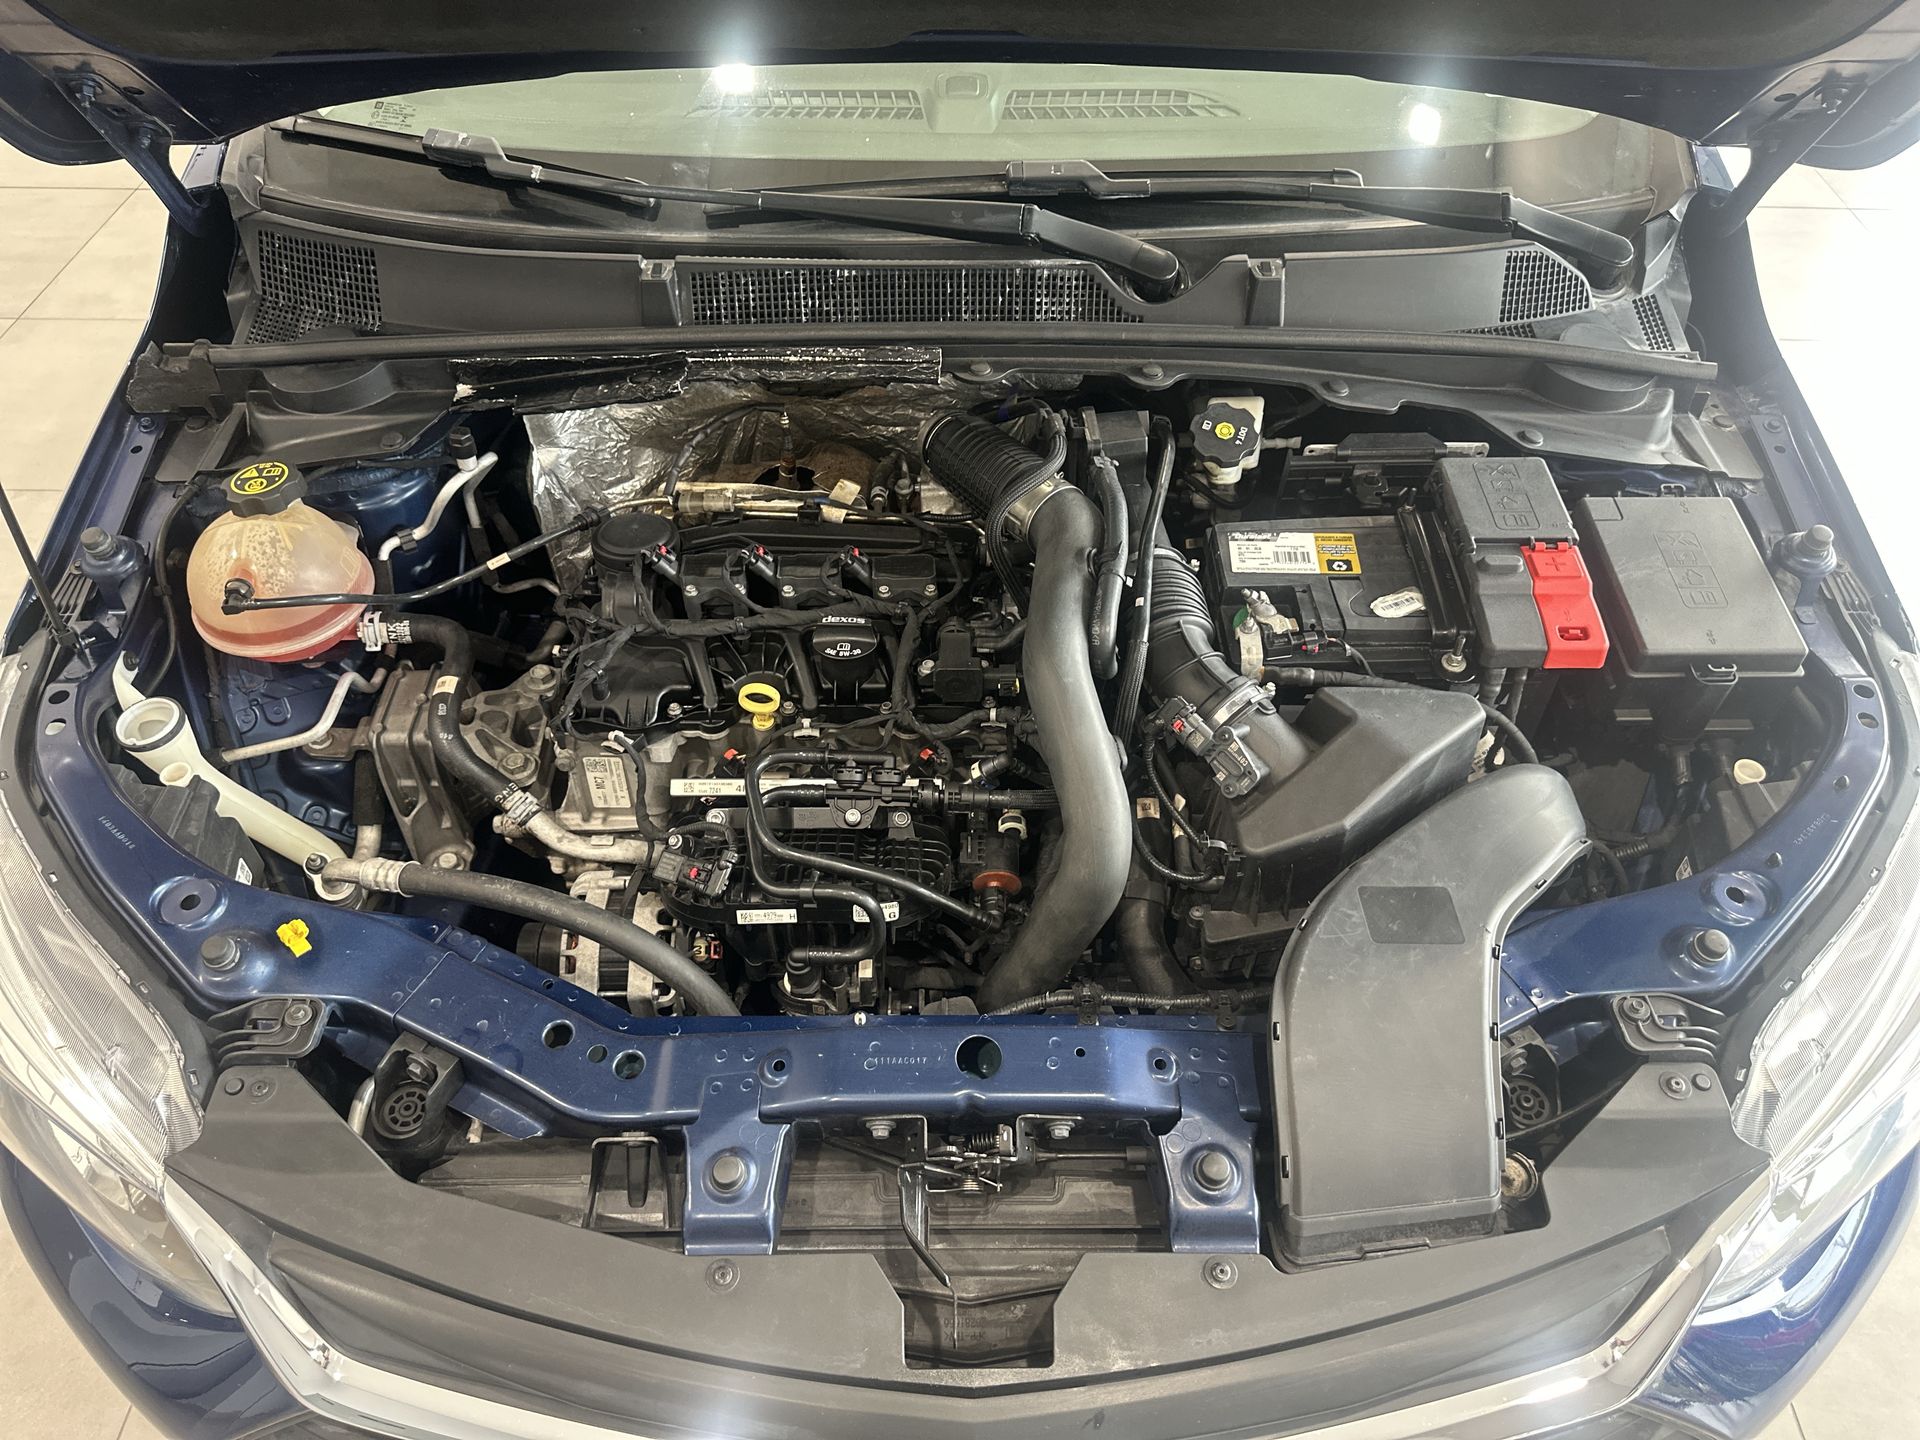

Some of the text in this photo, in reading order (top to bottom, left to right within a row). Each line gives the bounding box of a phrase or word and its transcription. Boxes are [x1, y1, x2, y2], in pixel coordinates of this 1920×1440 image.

[1237, 426, 1248, 441] DOT
[822, 615, 865, 624] dexos
[494, 782, 519, 804] ENG
[789, 912, 796, 921] H
[888, 911, 896, 919] G
